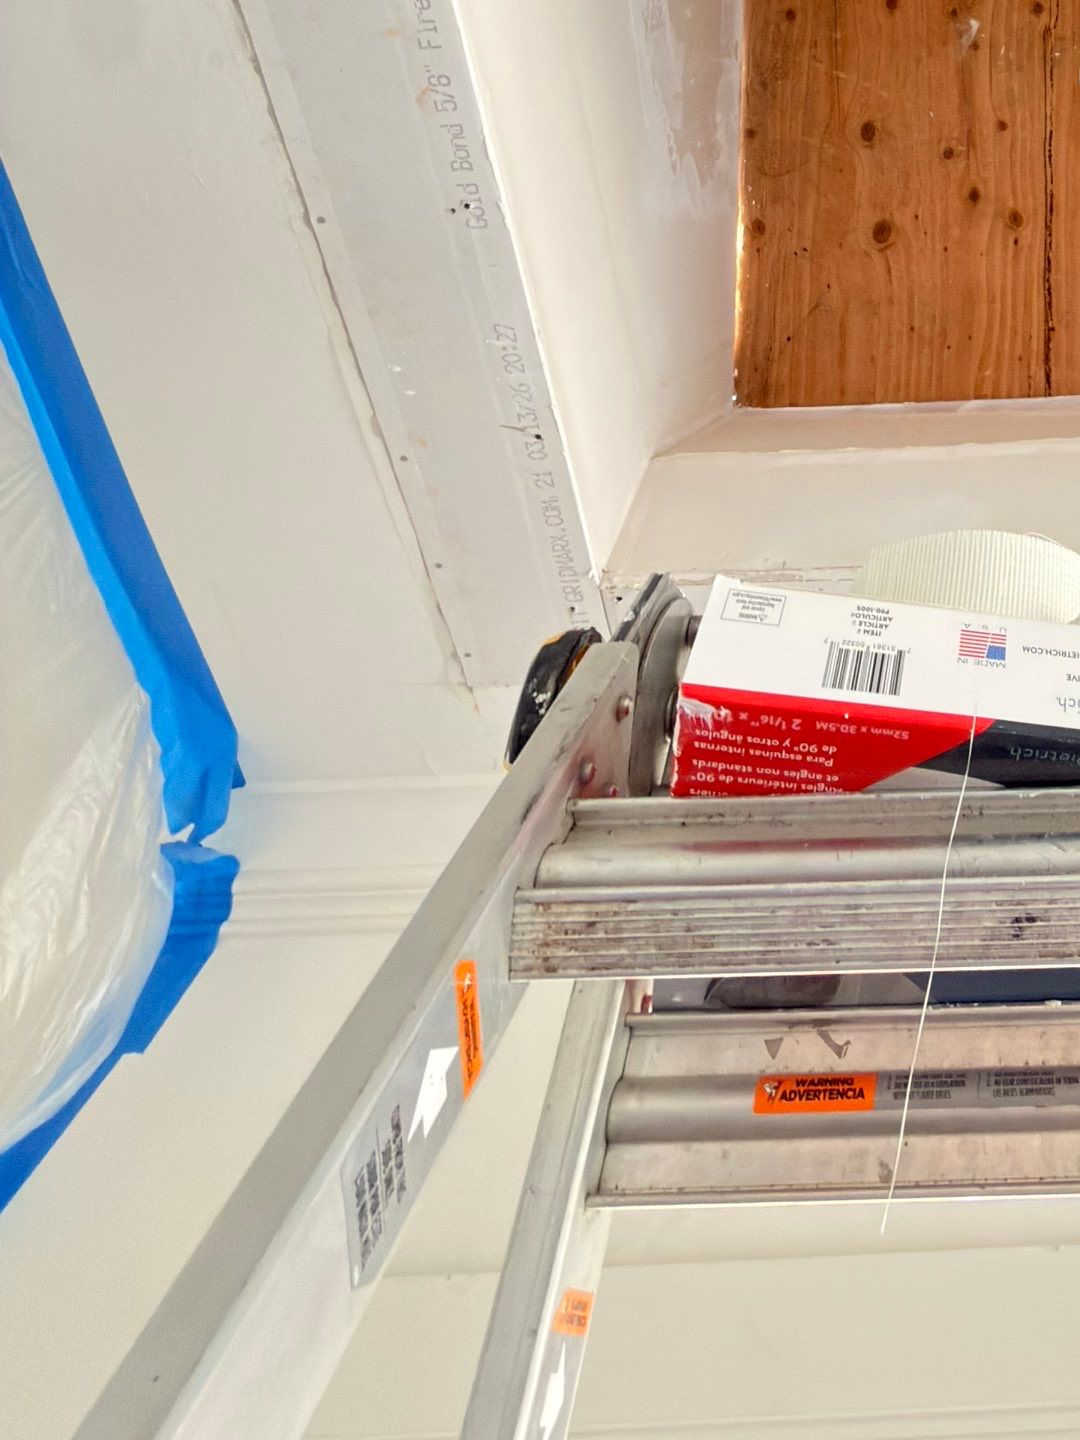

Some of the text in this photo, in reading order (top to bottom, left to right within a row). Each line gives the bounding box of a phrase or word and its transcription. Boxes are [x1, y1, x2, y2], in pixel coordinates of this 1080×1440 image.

[440, 124, 474, 172] Bond
[456, 184, 488, 230] Gold
[494, 323, 526, 374] 20:27
[534, 470, 556, 488] 21
[857, 619, 889, 629] ARTICLE
[862, 628, 881, 637] ITEM
[957, 656, 1006, 669] MADE IN
[738, 711, 748, 720] x
[792, 718, 801, 730] 2
[815, 720, 856, 734] 30.5M
[860, 725, 867, 734] x
[870, 727, 909, 739] 52mm
[694, 728, 837, 755] de 90° y otros ángulos
[693, 740, 833, 767] Para esquinas internas
[691, 758, 839, 782] et angles non standards
[718, 773, 733, 784] de
[737, 775, 797, 790] intérieurs
[800, 782, 842, 792] Angles
[795, 1077, 855, 1087] WARNING
[779, 1087, 865, 1102] ADVERTENCIA
